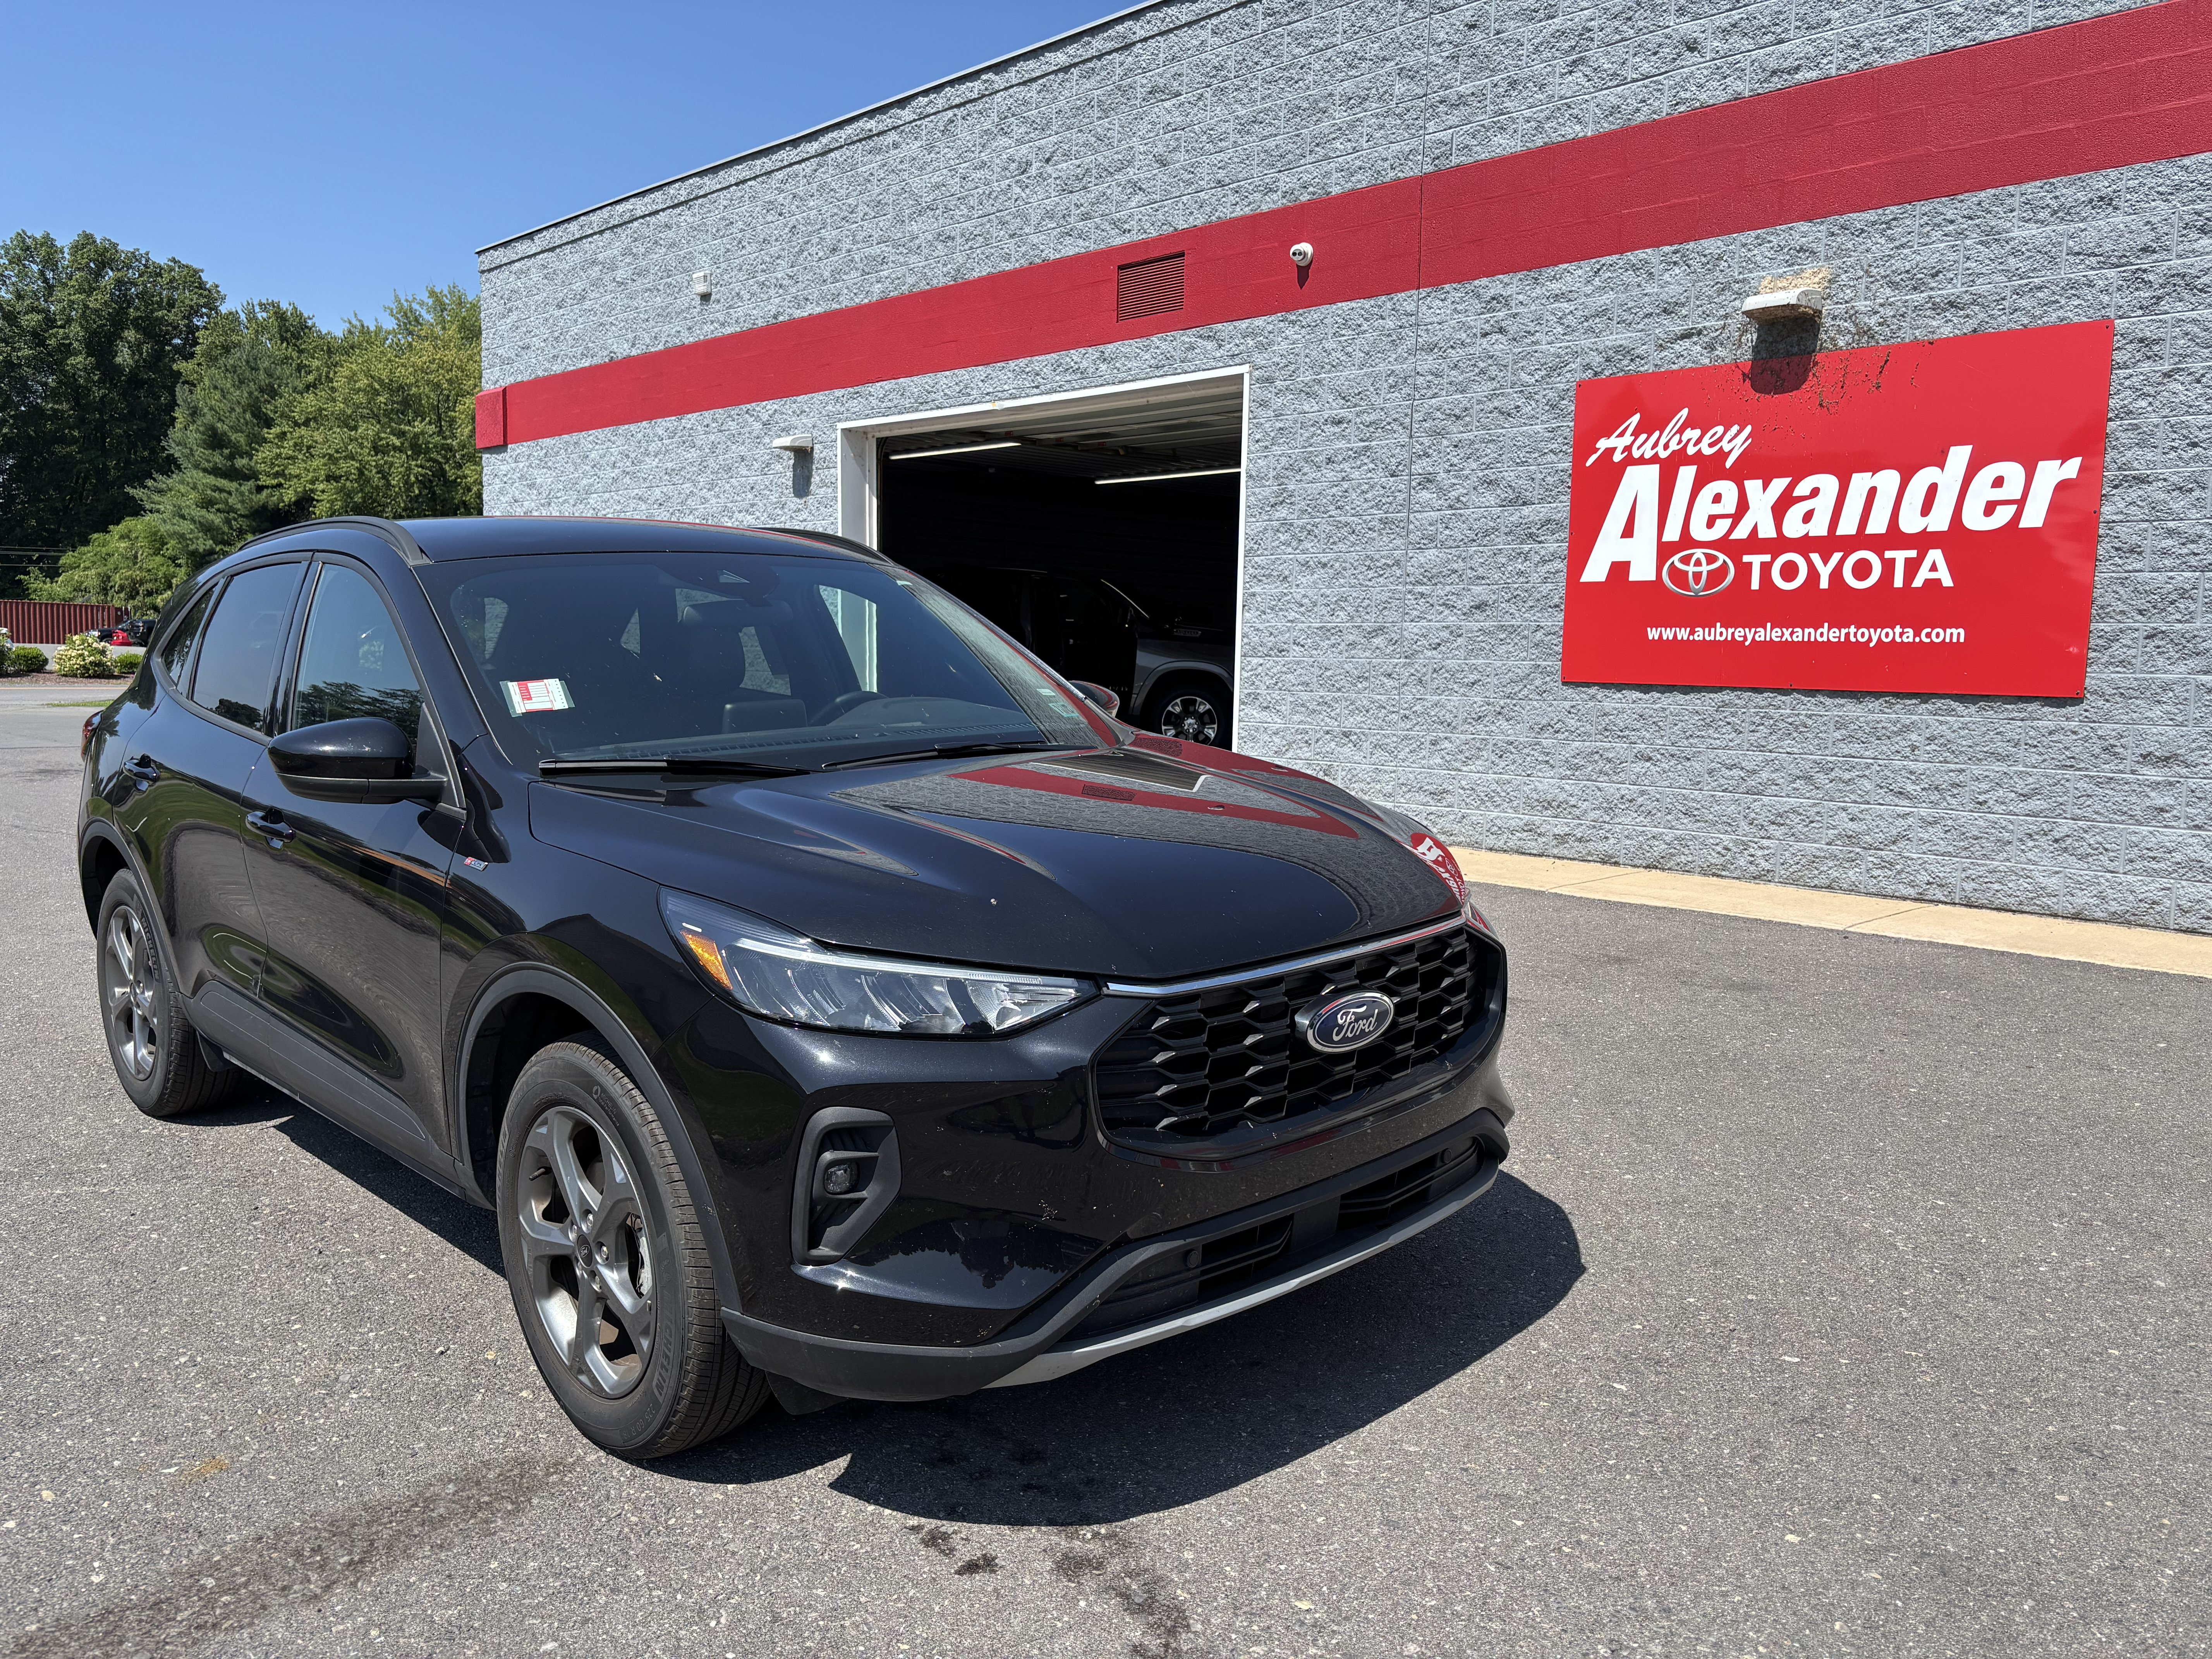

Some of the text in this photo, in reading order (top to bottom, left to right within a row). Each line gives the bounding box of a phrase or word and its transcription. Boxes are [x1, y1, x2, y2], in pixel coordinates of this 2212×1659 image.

[1586, 407, 1752, 469] Aubrey
[1580, 445, 2082, 582] Alexander
[1743, 549, 1953, 590] TOYOTA
[1647, 623, 1964, 647] www.aubreyalexandertoyota.com
[141, 917, 160, 980] MICHELIN
[1333, 1005, 1378, 1042] Ford
[600, 1092, 617, 1115] MICHELIN
[655, 1290, 673, 1397] MICHELIN
